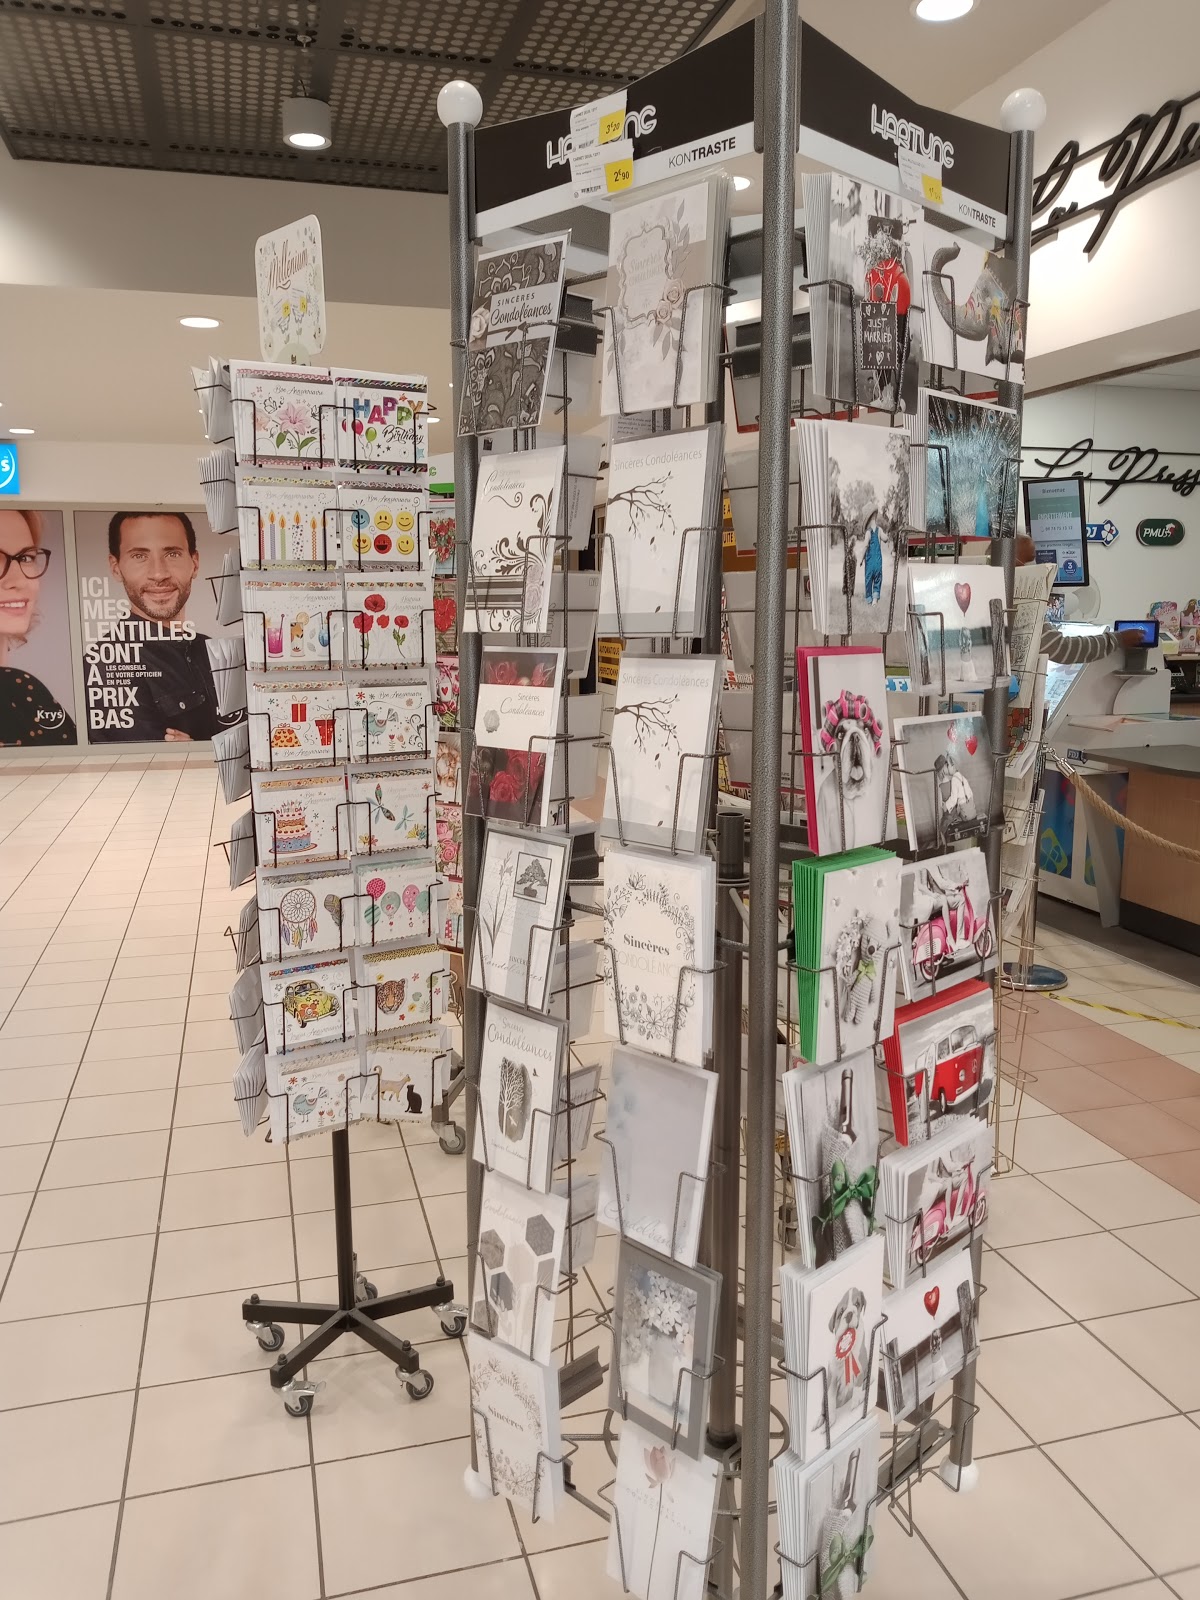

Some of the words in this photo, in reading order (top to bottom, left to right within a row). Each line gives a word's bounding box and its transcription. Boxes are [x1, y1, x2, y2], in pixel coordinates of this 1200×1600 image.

[546, 104, 657, 169] HANG
[871, 104, 954, 169] HARTUNG
[668, 136, 736, 169] KONTRASTE
[614, 169, 630, 182] 2€90
[1083, 100, 1200, 254] Pr
[958, 203, 996, 228] KONTRASTE
[491, 302, 553, 327] Condoléances
[867, 318, 888, 329] JUST
[864, 331, 893, 344] MARRIED
[353, 396, 424, 425] HAPPY
[382, 425, 425, 443] Birthday
[1143, 527, 1165, 538] PMU
[1067, 562, 1073, 570] 3
[82, 576, 109, 598] ICI
[83, 599, 130, 620] MES
[84, 621, 196, 642] LENTILLES
[85, 643, 143, 664] SONT
[87, 662, 103, 686] À
[89, 687, 139, 708] PRIX
[500, 697, 546, 717] Condoléances
[36, 709, 63, 723] Krys
[90, 709, 134, 729] BAS
[1068, 750, 1079, 759] FDJ
[623, 933, 670, 956] Sincères
[616, 950, 681, 979] ONDOLÉANC
[487, 1023, 552, 1062] Condoléances
[488, 1404, 524, 1433] Sincères
